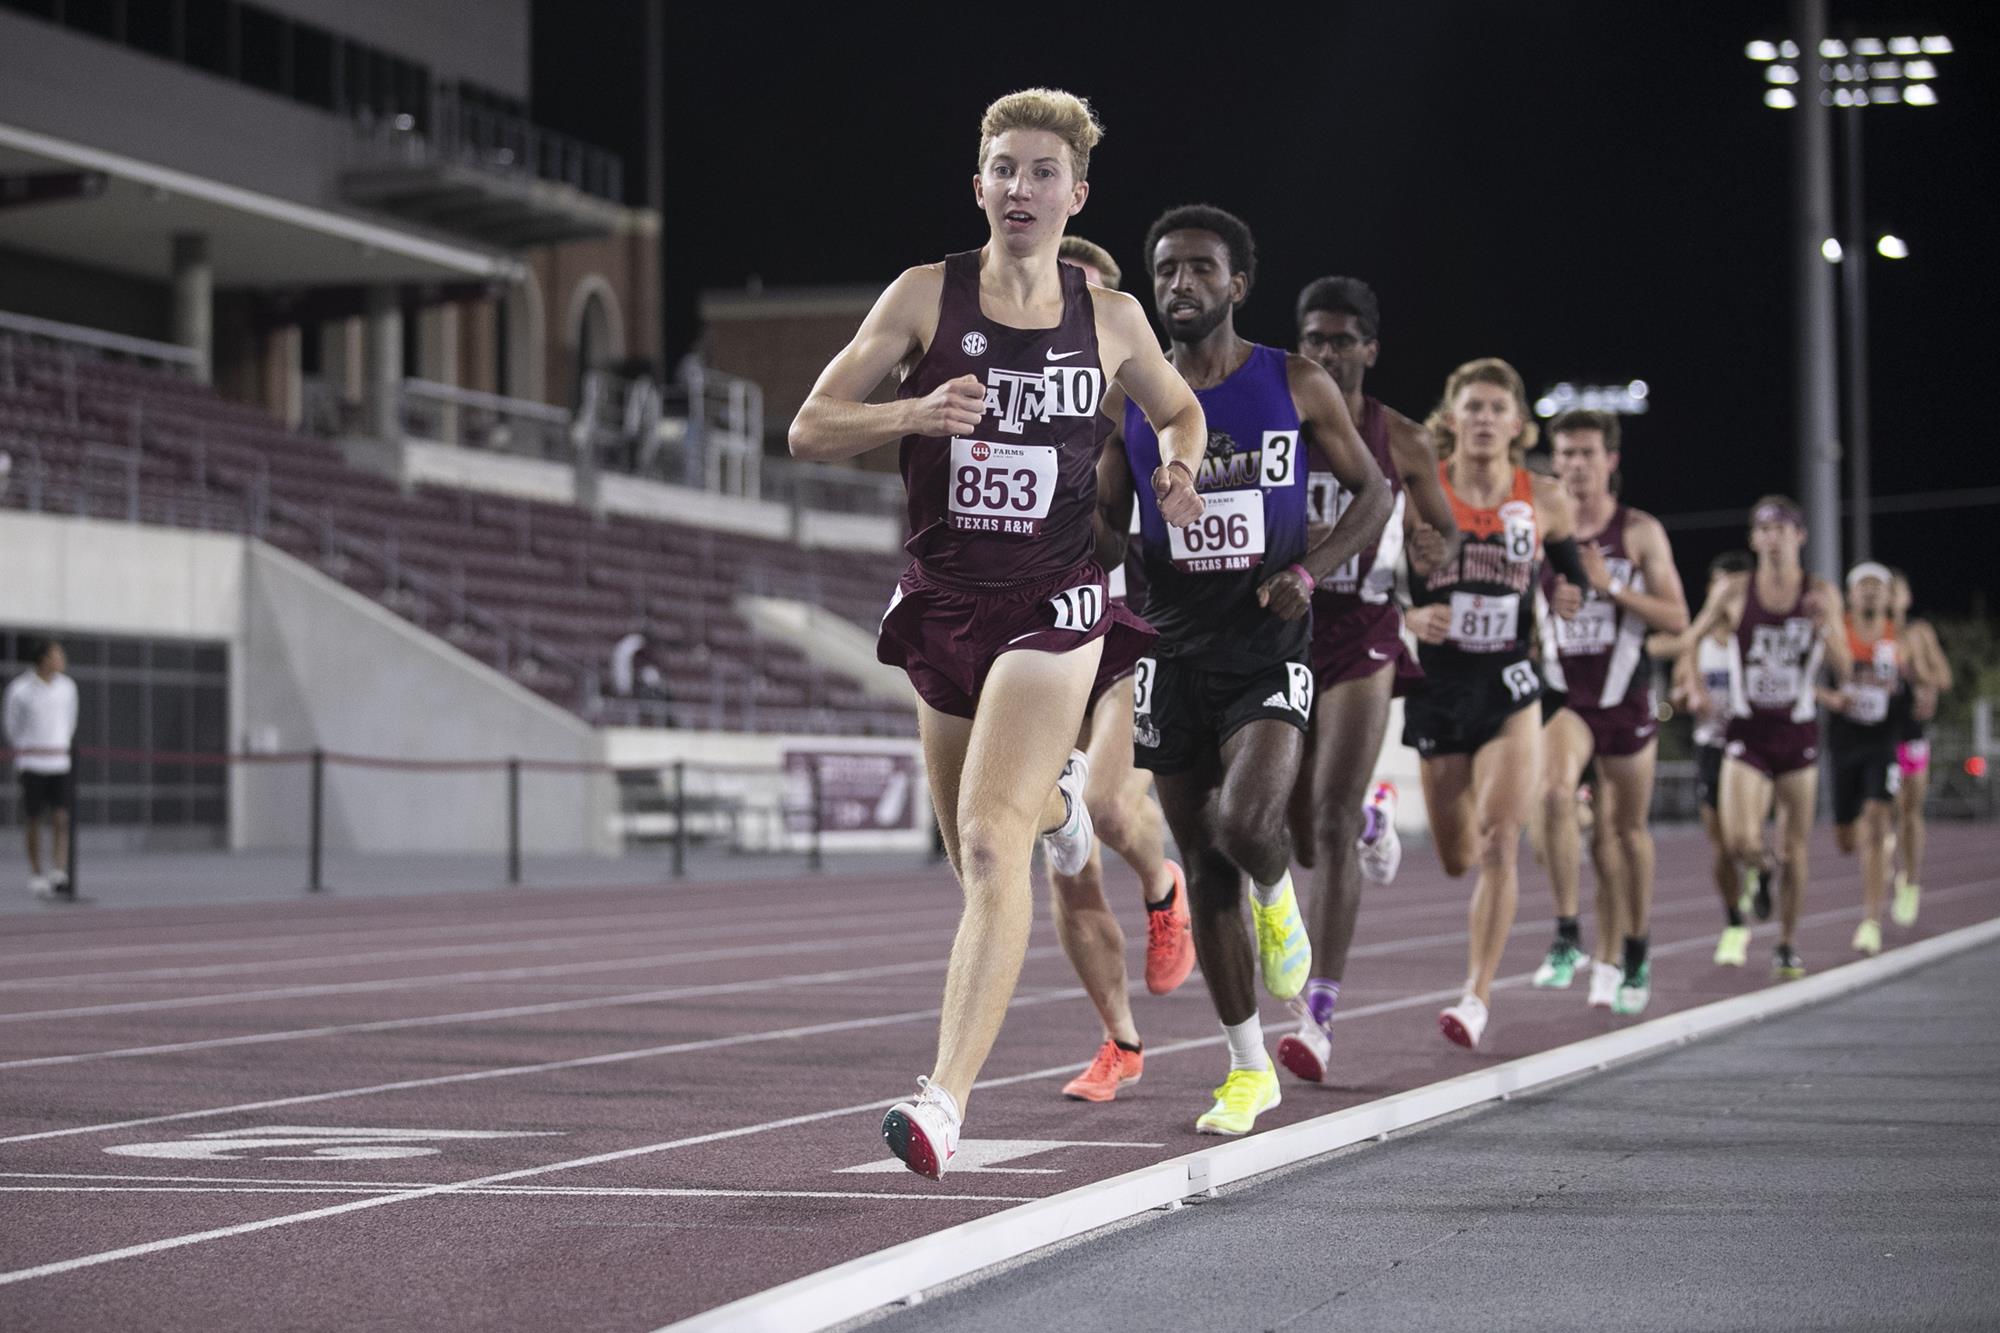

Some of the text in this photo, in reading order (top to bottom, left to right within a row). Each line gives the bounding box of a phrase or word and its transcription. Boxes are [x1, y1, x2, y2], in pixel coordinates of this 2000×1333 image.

[964, 334, 985, 354] SEC
[1049, 368, 1093, 414] 10
[993, 448, 1025, 456] FARMS
[1266, 435, 1291, 482] 3
[956, 465, 1037, 511] 853
[956, 516, 1033, 533] TEXAS A&M
[1183, 513, 1249, 552] 696
[1187, 556, 1250, 571] TEXAS A&M
[1054, 587, 1096, 629] 10
[1462, 612, 1508, 636] 817
[1135, 661, 1148, 708] 3
